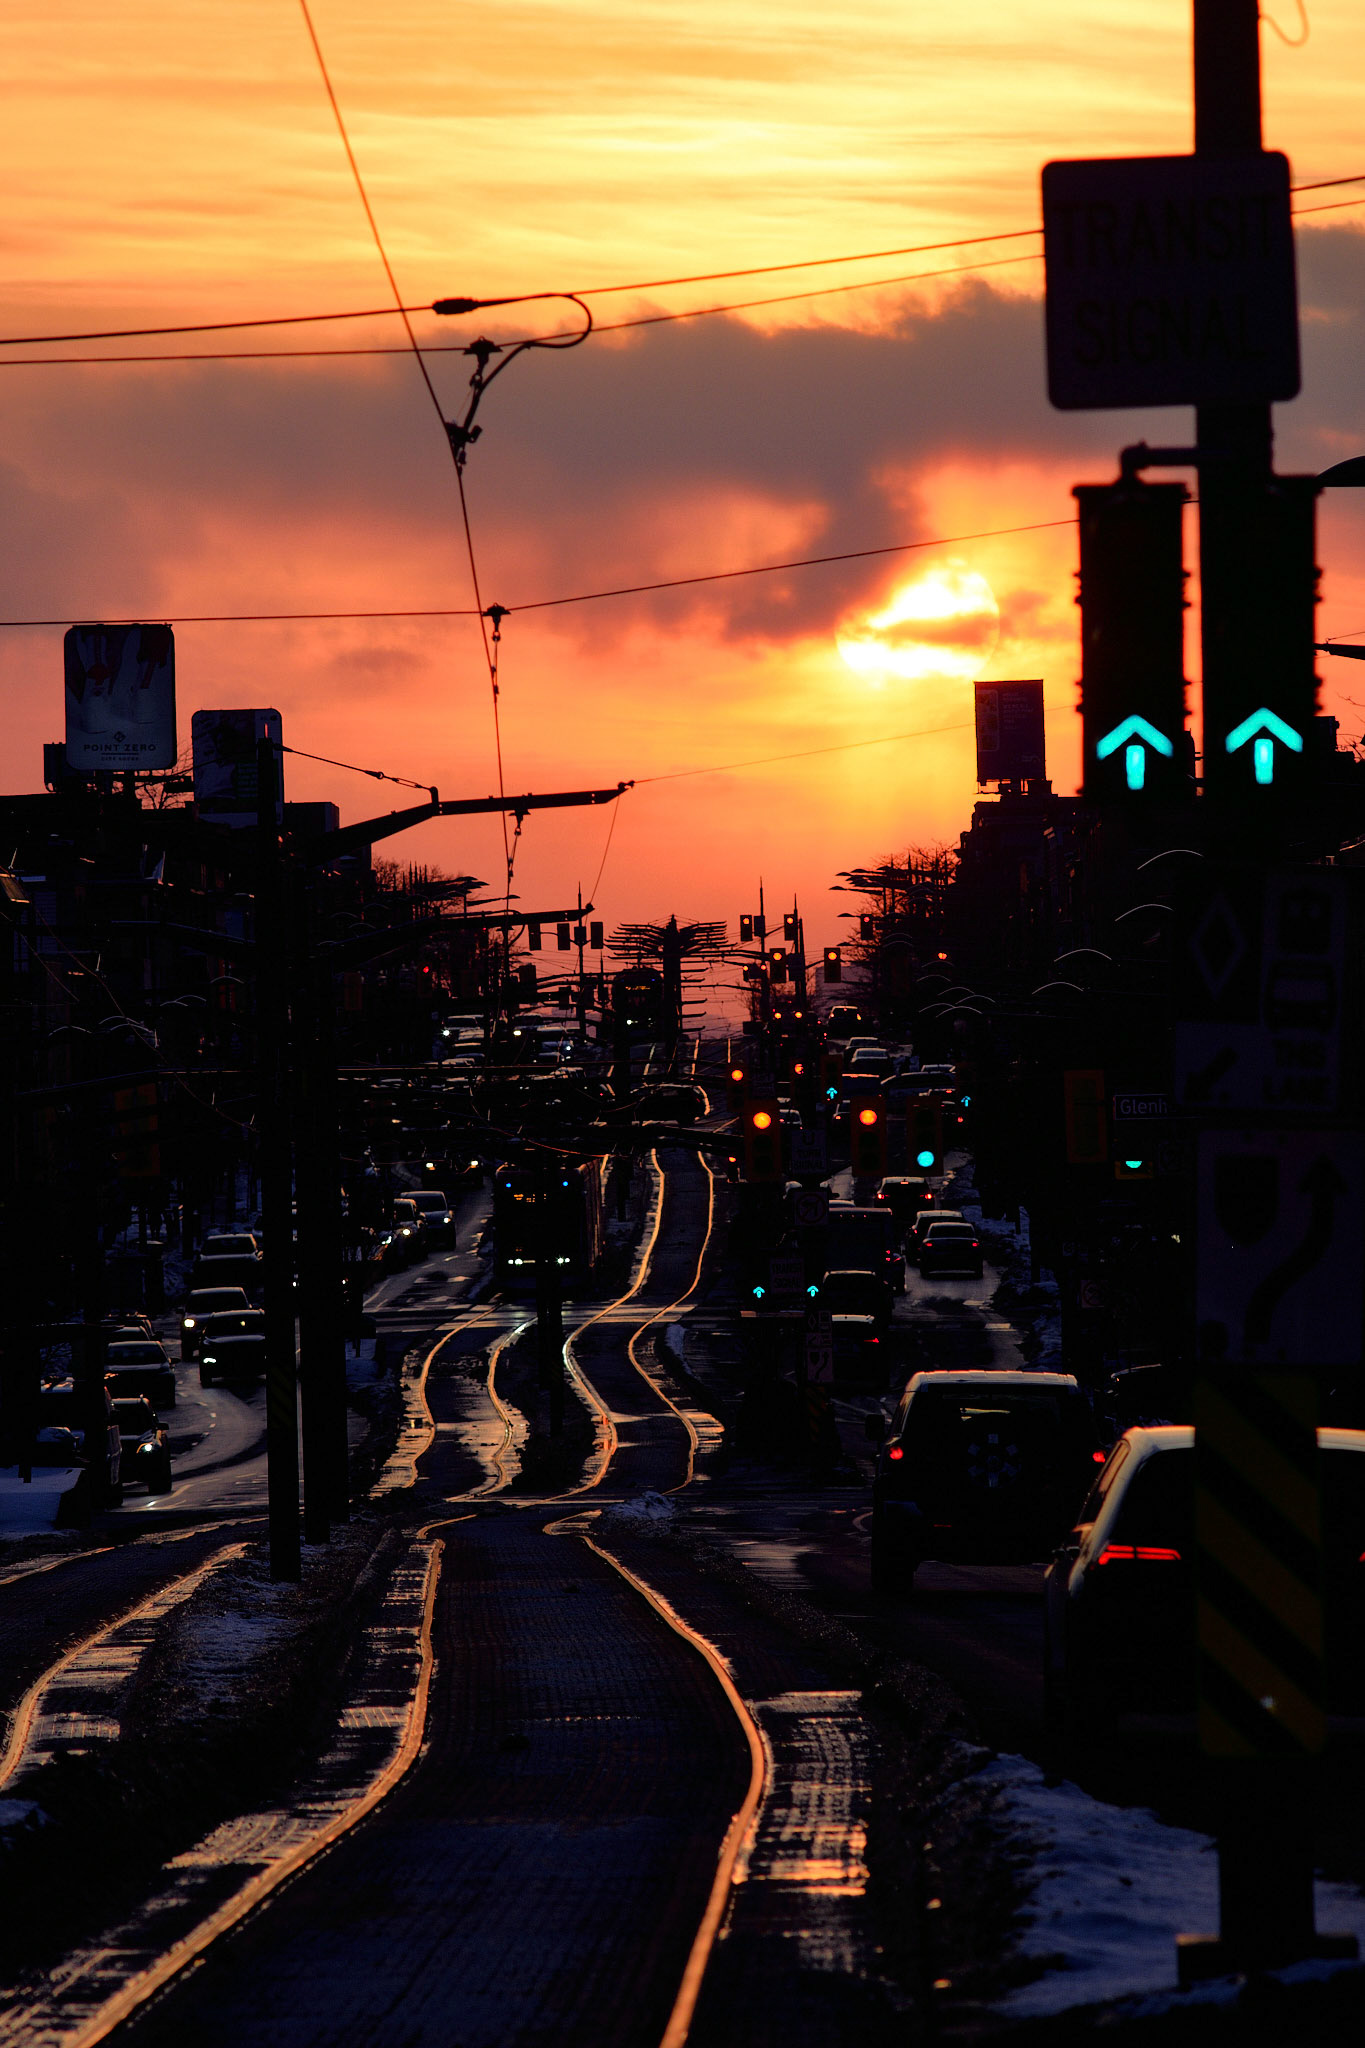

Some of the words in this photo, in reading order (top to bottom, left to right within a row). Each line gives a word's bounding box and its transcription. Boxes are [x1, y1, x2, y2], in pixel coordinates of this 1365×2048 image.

[1057, 193, 1278, 267] TRANSIT
[1073, 295, 1267, 369] SIGNAL
[84, 743, 119, 752] POINT
[124, 743, 157, 752] ZERO
[803, 1131, 815, 1146] U
